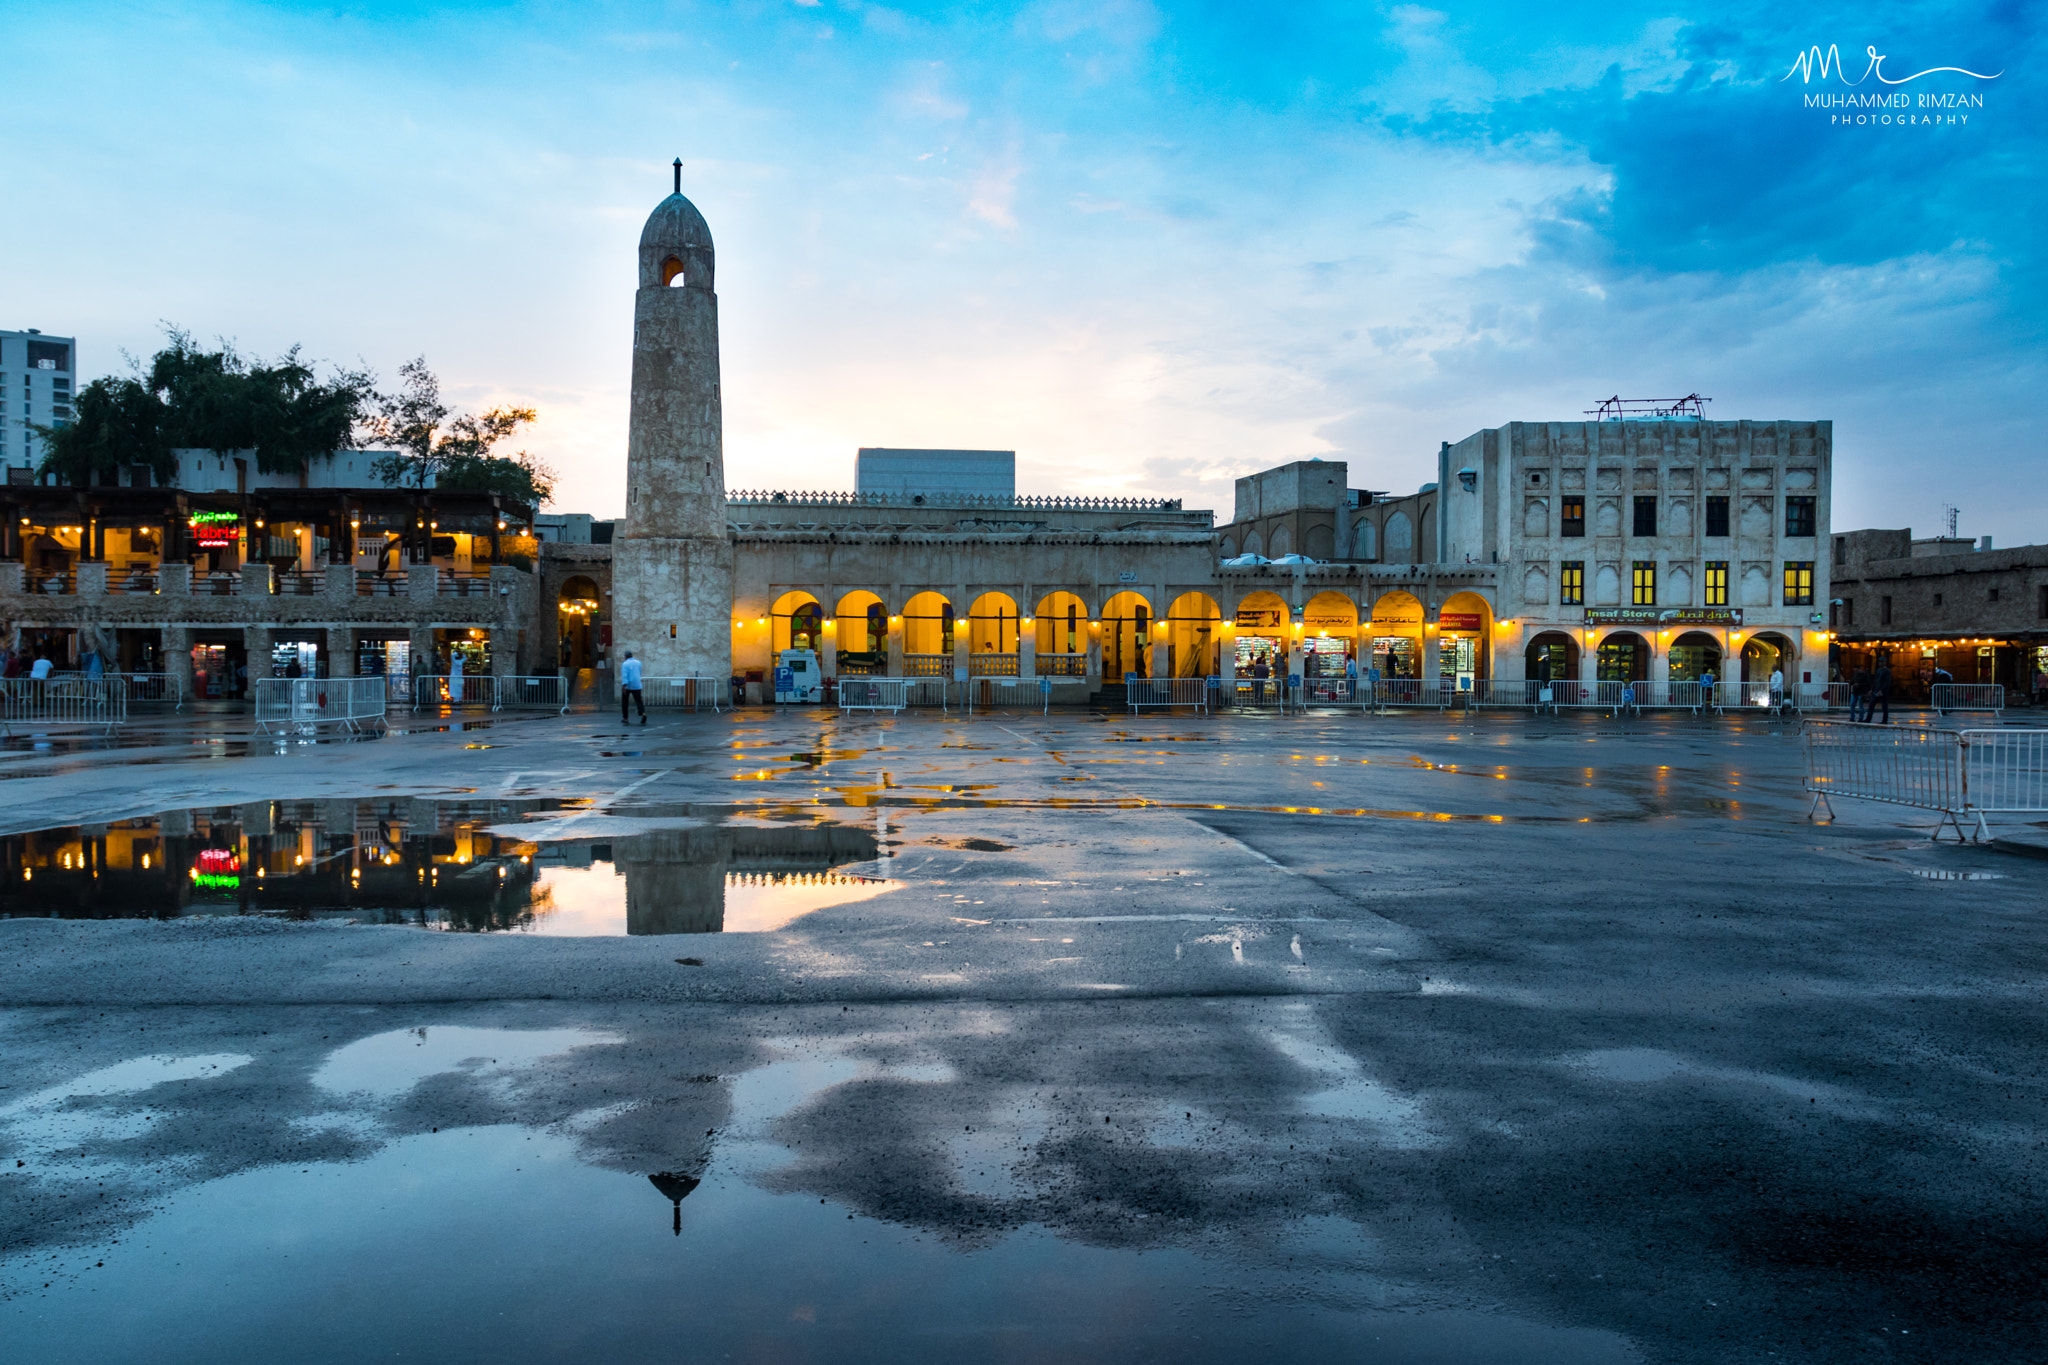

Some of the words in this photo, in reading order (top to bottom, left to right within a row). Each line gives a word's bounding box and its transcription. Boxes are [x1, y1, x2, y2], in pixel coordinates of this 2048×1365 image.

[188, 523, 239, 540] Tabriz
[1587, 610, 1618, 618] Insaf
[1622, 610, 1656, 618] Store
[780, 668, 789, 679] P
